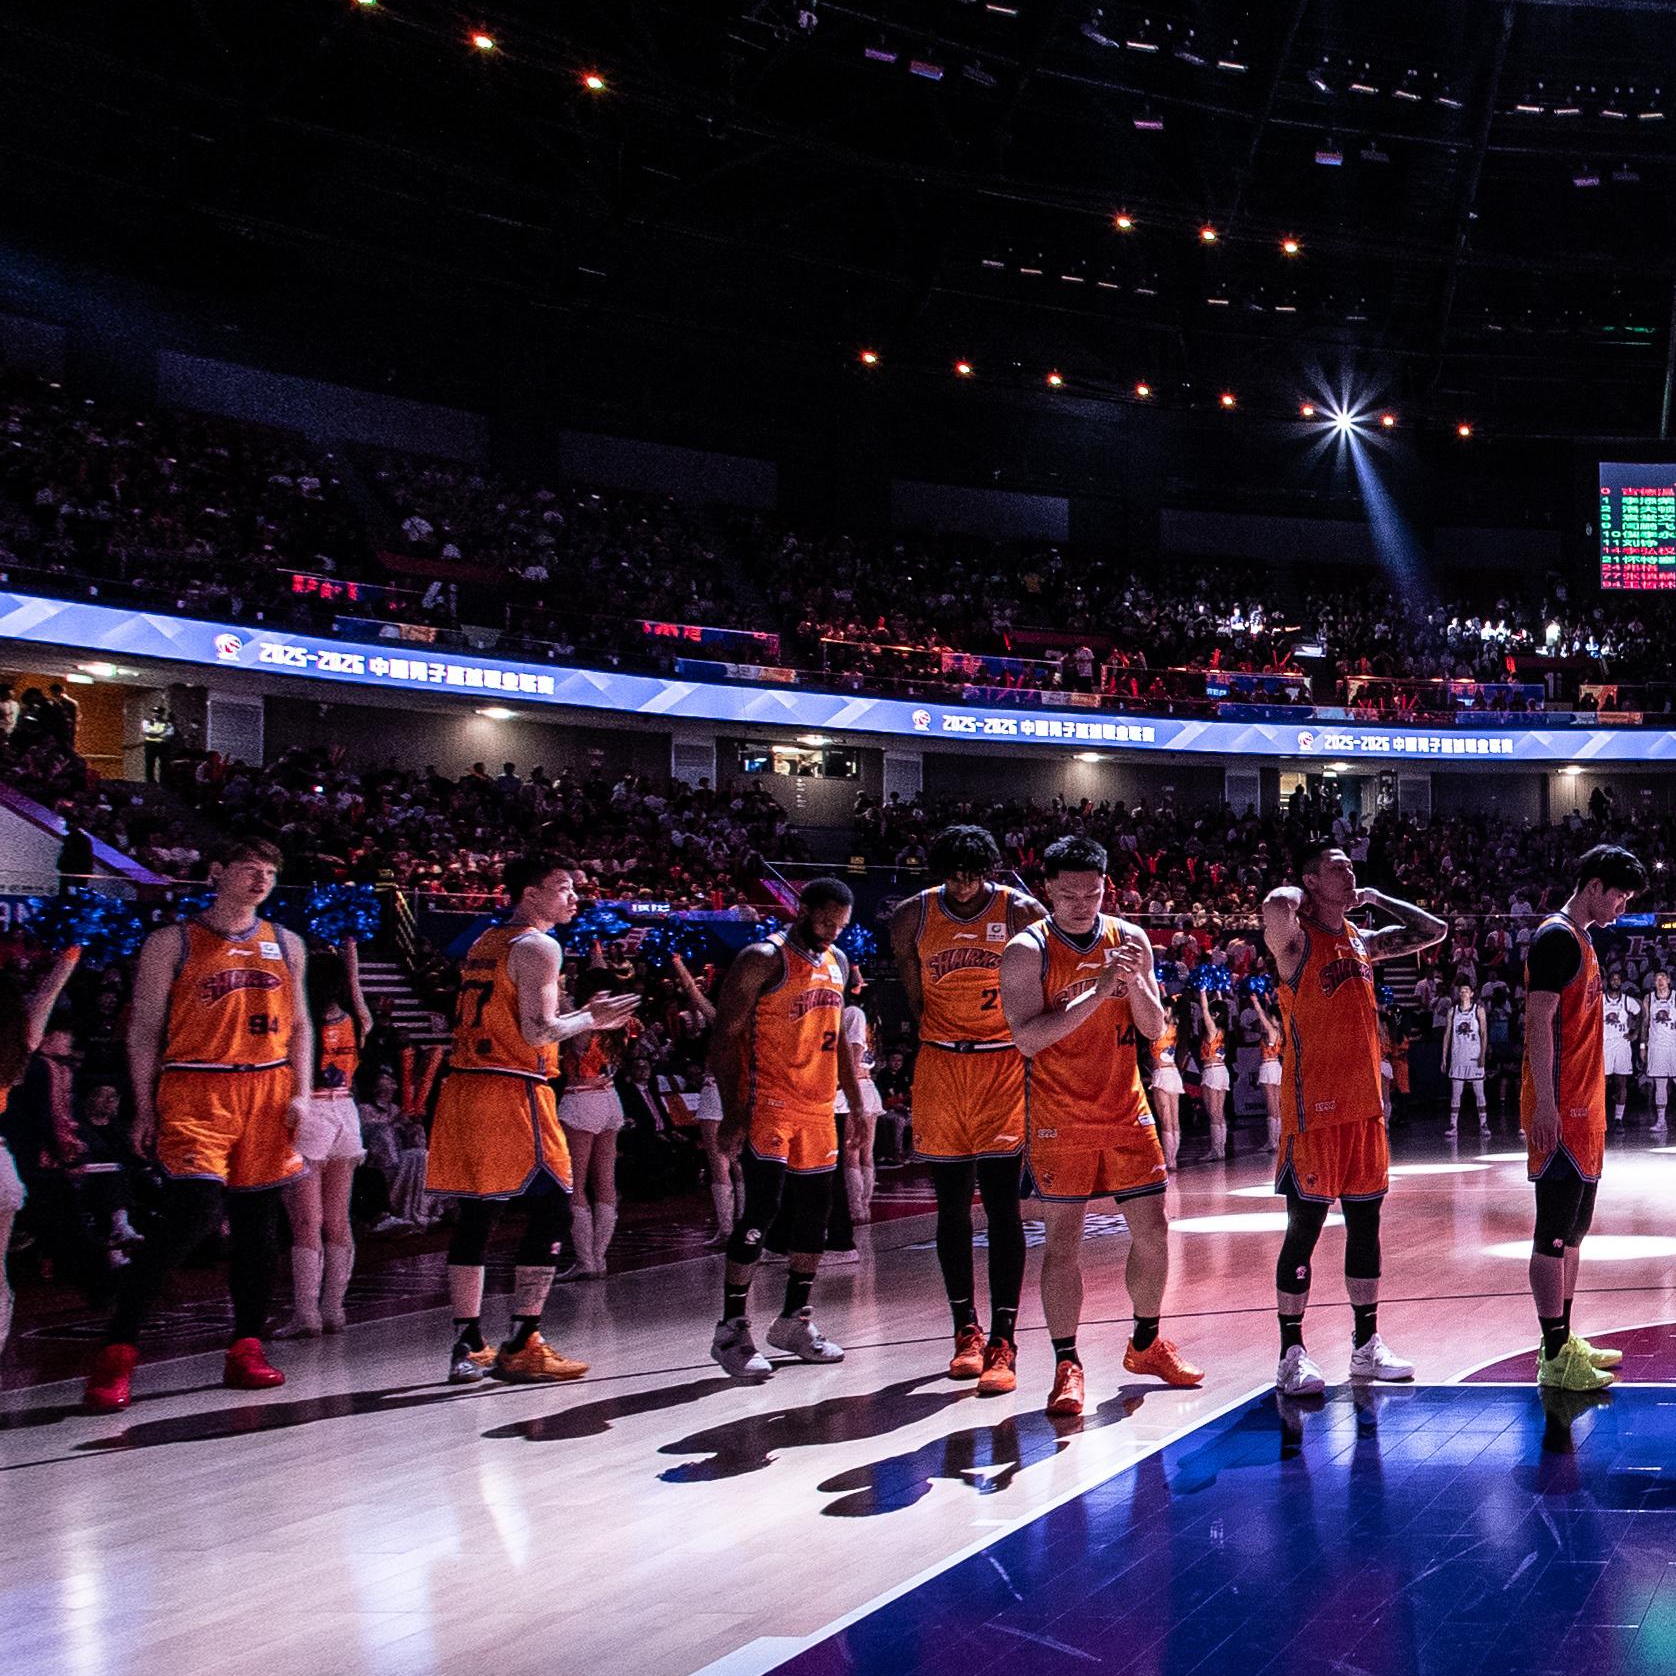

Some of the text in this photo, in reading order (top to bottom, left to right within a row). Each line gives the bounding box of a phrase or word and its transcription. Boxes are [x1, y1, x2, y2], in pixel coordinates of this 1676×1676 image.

[259, 642, 365, 675] 2025-2026
[942, 714, 1017, 735] 2025-2026
[1324, 735, 1390, 751] 2025-2026
